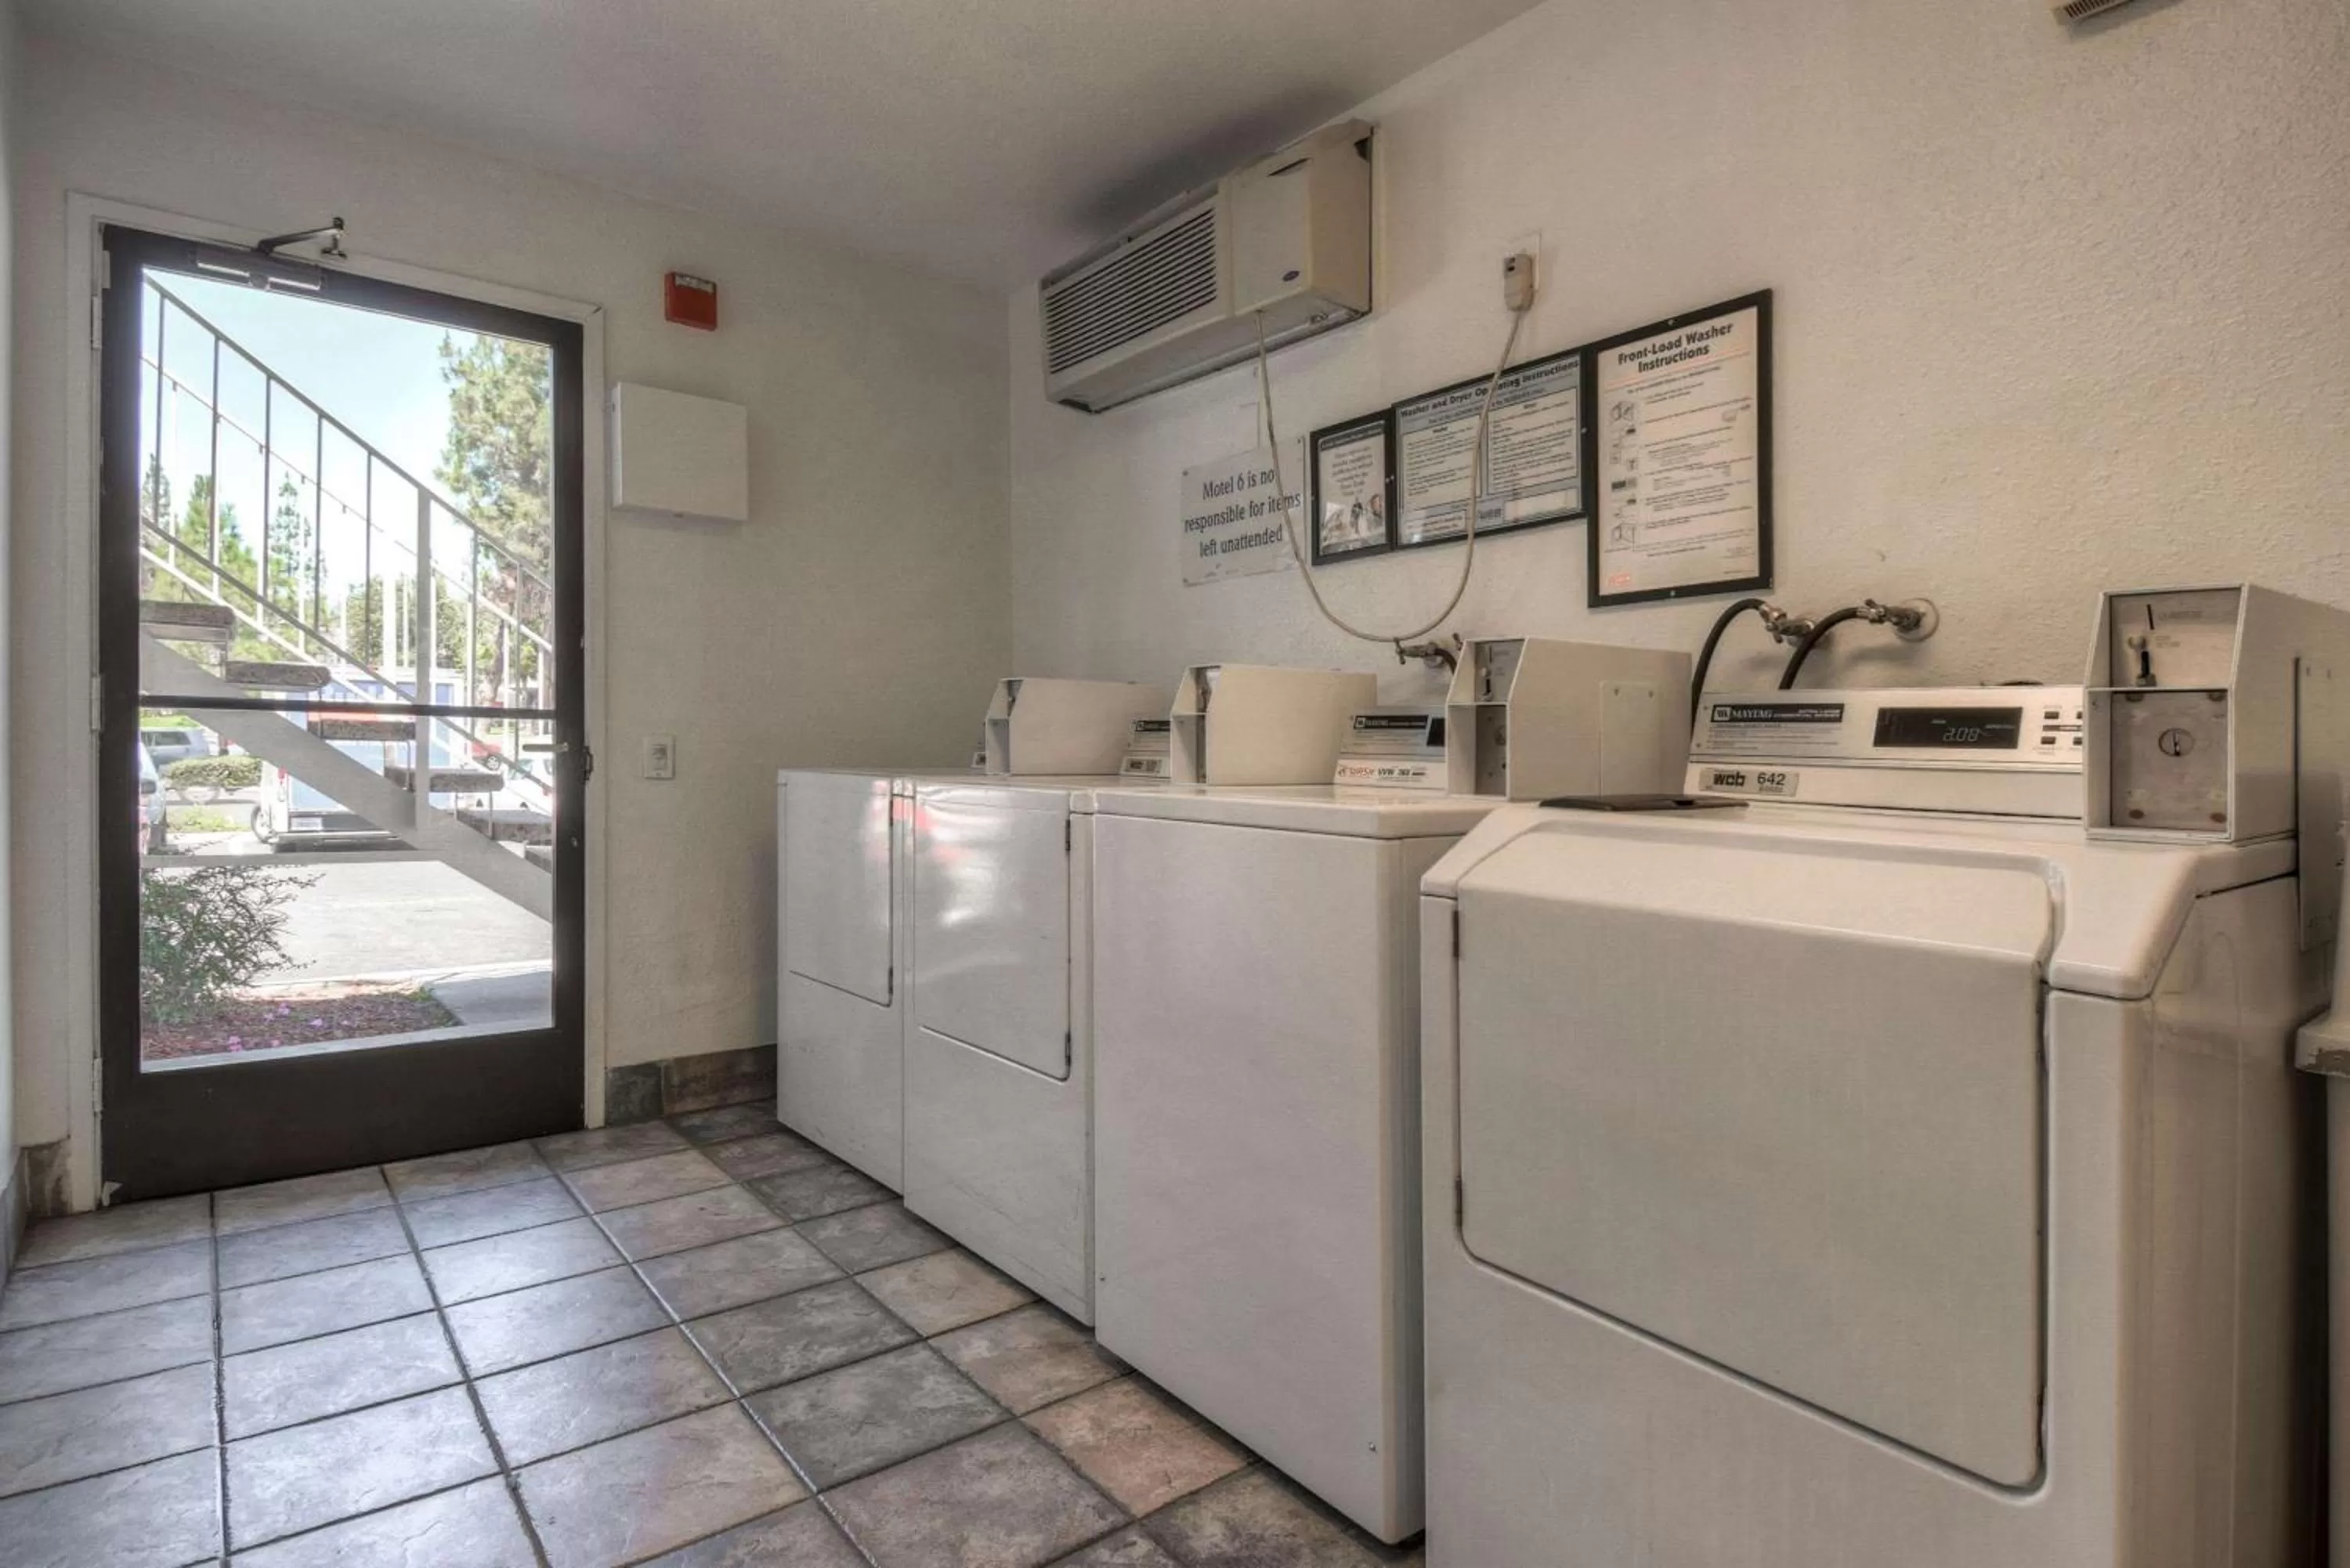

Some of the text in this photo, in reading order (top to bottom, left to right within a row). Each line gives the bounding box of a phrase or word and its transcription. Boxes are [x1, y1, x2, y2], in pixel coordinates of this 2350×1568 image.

[1618, 323, 1734, 365] Front-Load Washer
[1638, 345, 1710, 373] Instructions
[1400, 404, 1429, 417] Washer
[1431, 397, 1447, 409] and
[1450, 392, 1472, 404] Dryer
[1522, 360, 1578, 382] Instructions
[1202, 476, 1235, 500] Motel
[1237, 472, 1245, 491] 6
[1248, 470, 1257, 489] is
[1184, 493, 1301, 533] responsible for items
[1199, 522, 1283, 558] left unattended
[1757, 771, 1786, 786] 642
